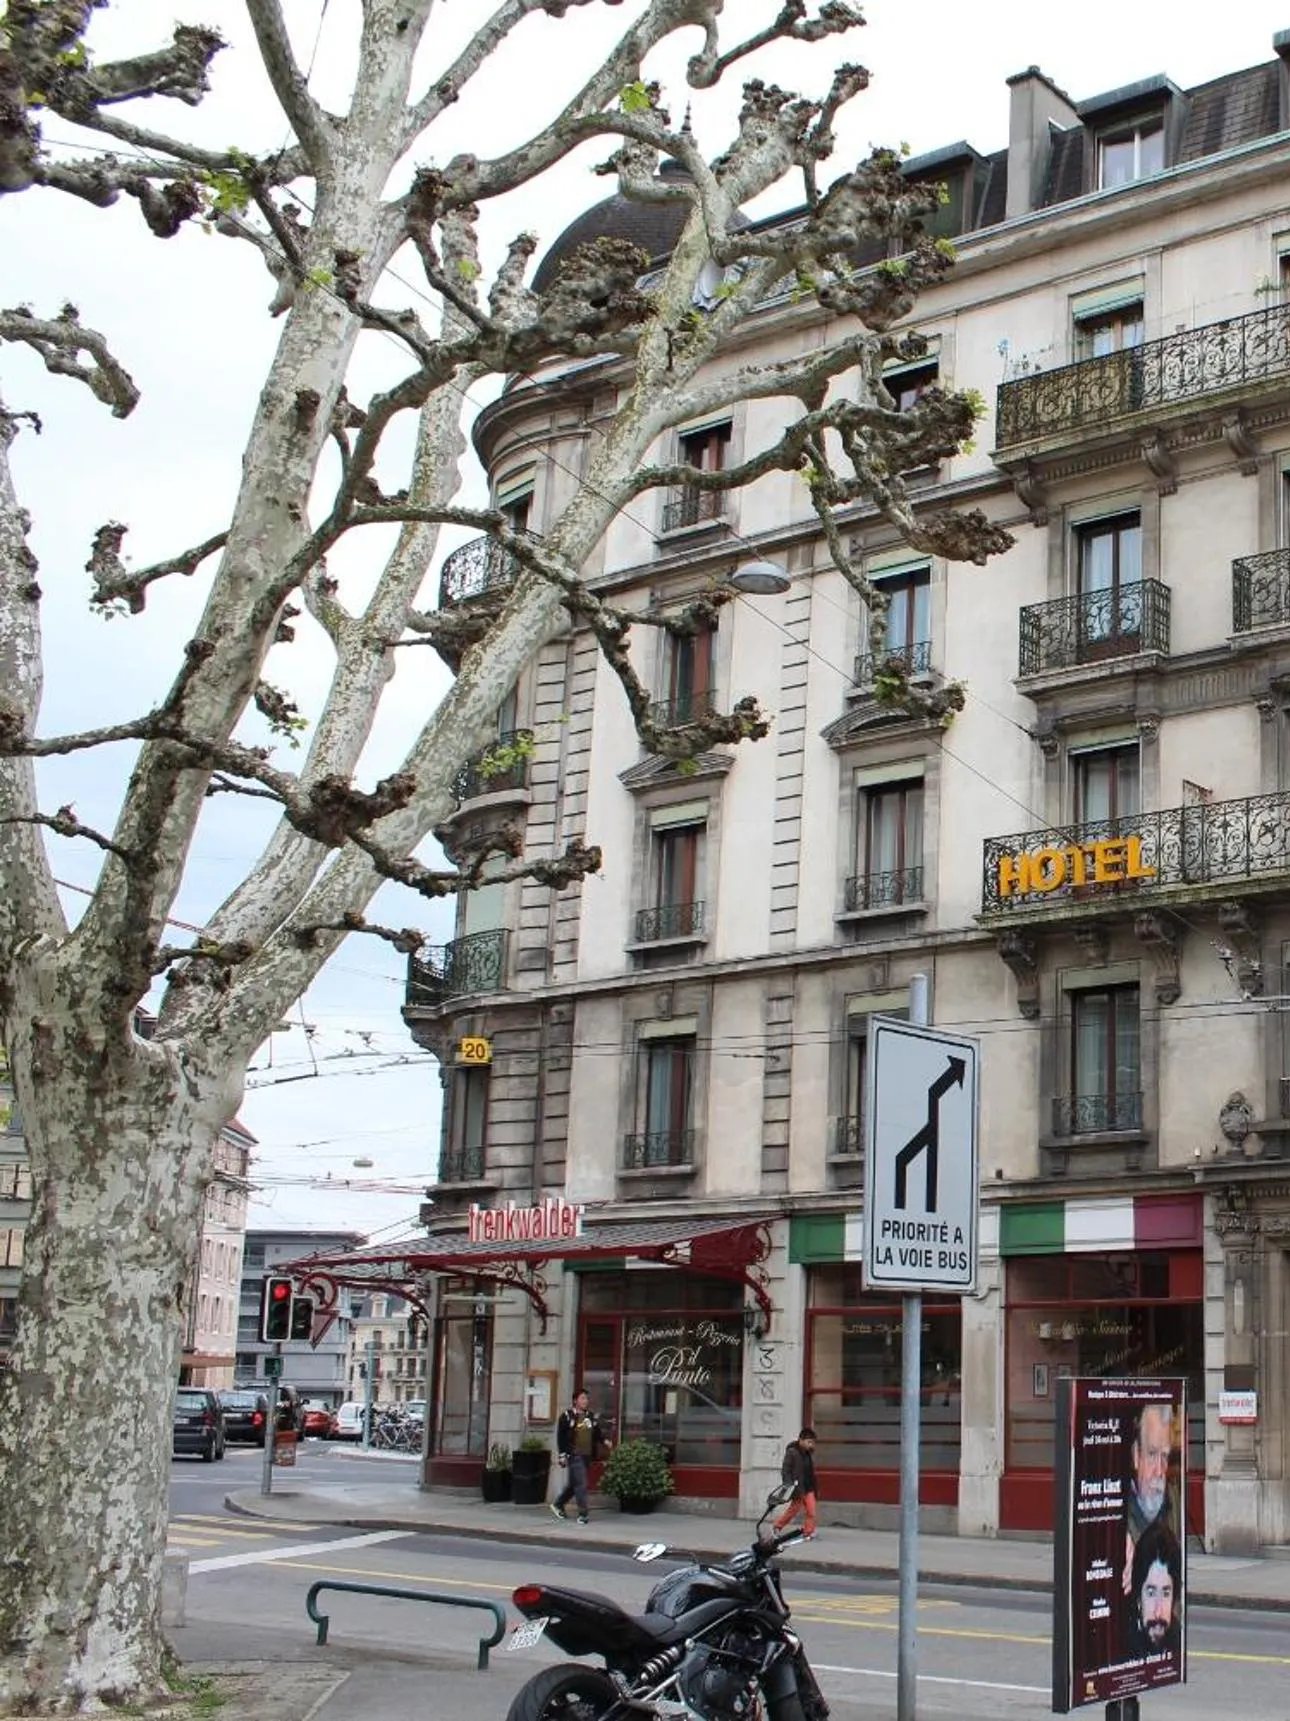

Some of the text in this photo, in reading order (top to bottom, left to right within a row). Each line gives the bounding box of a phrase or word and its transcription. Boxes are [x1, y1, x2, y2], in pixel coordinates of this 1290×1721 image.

[998, 835, 1157, 897] HOTEL
[465, 1043, 485, 1059] 20
[881, 1220, 964, 1244] PRIORITÉ A
[876, 1246, 968, 1271] LA VOIE BUS
[648, 1345, 712, 1385] Punto
